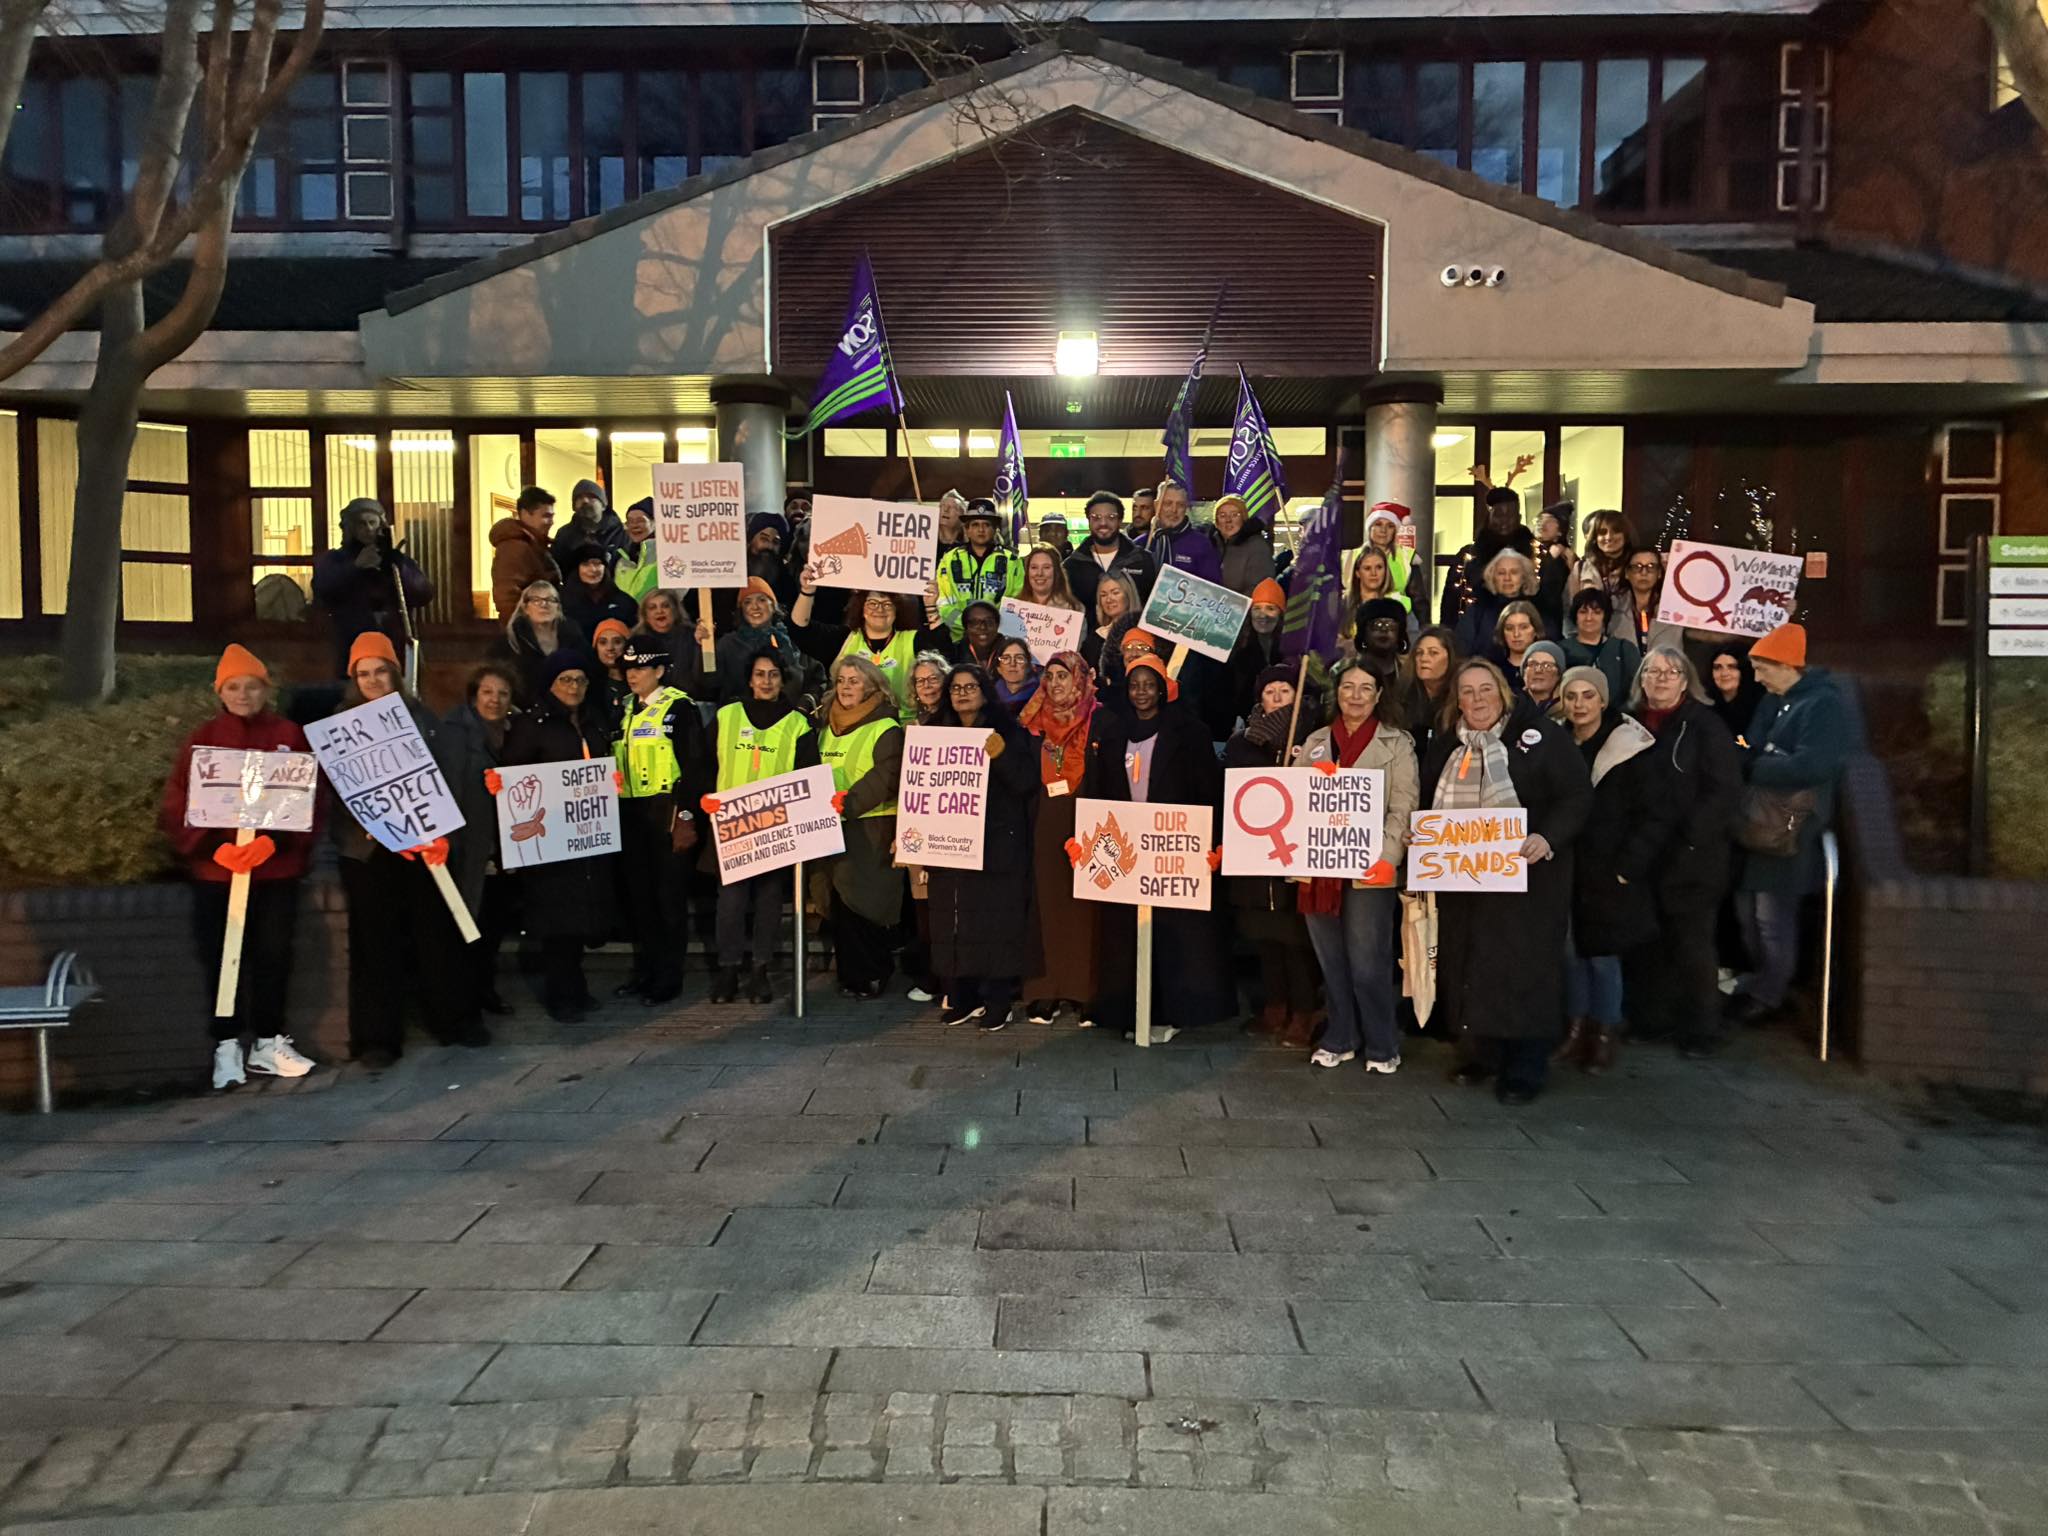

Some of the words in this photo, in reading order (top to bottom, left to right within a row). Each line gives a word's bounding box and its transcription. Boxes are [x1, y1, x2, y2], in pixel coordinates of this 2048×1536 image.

[660, 481, 684, 499] WE
[691, 480, 739, 499] LISTEN
[660, 504, 681, 518] WE
[686, 502, 739, 518] SUPPORT
[662, 523, 690, 543] WE
[697, 521, 741, 542] CARE
[877, 511, 931, 540] HEAR
[890, 538, 916, 555] OUR
[710, 560, 737, 568] Country
[874, 553, 932, 581] VOICE
[377, 705, 414, 733] ME
[746, 743, 776, 753] Sadico
[909, 745, 932, 766] WE
[937, 745, 985, 767] LISTEN
[197, 762, 221, 780] WE
[328, 744, 402, 792] PROTECT
[561, 764, 607, 786] SAFETY
[906, 770, 925, 787] WE
[930, 770, 982, 788] SUPPORT
[1309, 775, 1371, 791] WOMEN'S
[350, 768, 443, 824] RESPECT
[573, 788, 581, 798] IS
[584, 785, 598, 796] OUR
[716, 782, 809, 822] SANDWELL
[564, 796, 608, 823] RIGHT
[905, 791, 931, 815] WE
[938, 792, 981, 816] CARE
[1309, 792, 1371, 813] RIGHTS
[384, 802, 437, 842] ME
[576, 823, 592, 835] NOT
[595, 822, 602, 832] A
[719, 806, 786, 841] STANDS
[1154, 811, 1188, 832] OUR
[1328, 813, 1350, 826] ARE
[754, 827, 793, 847] VIOLENCE
[795, 816, 837, 836] TOWARDS
[928, 834, 946, 842] Black
[947, 835, 974, 846] Country
[1308, 826, 1370, 848] HUMAN
[1408, 815, 1526, 846] SANDWELL
[567, 833, 612, 852] PRIVILEGE
[928, 843, 958, 851] Women's
[959, 844, 970, 852] Aid
[1141, 834, 1200, 852] STREETS
[723, 853, 753, 871] WOMEN
[754, 848, 771, 862] AND
[772, 840, 796, 857] GIRLS
[1154, 856, 1185, 875] OUR
[1307, 848, 1370, 869] RIGHTS
[1416, 851, 1521, 882] STANDS
[1140, 875, 1200, 898] SAFETY
